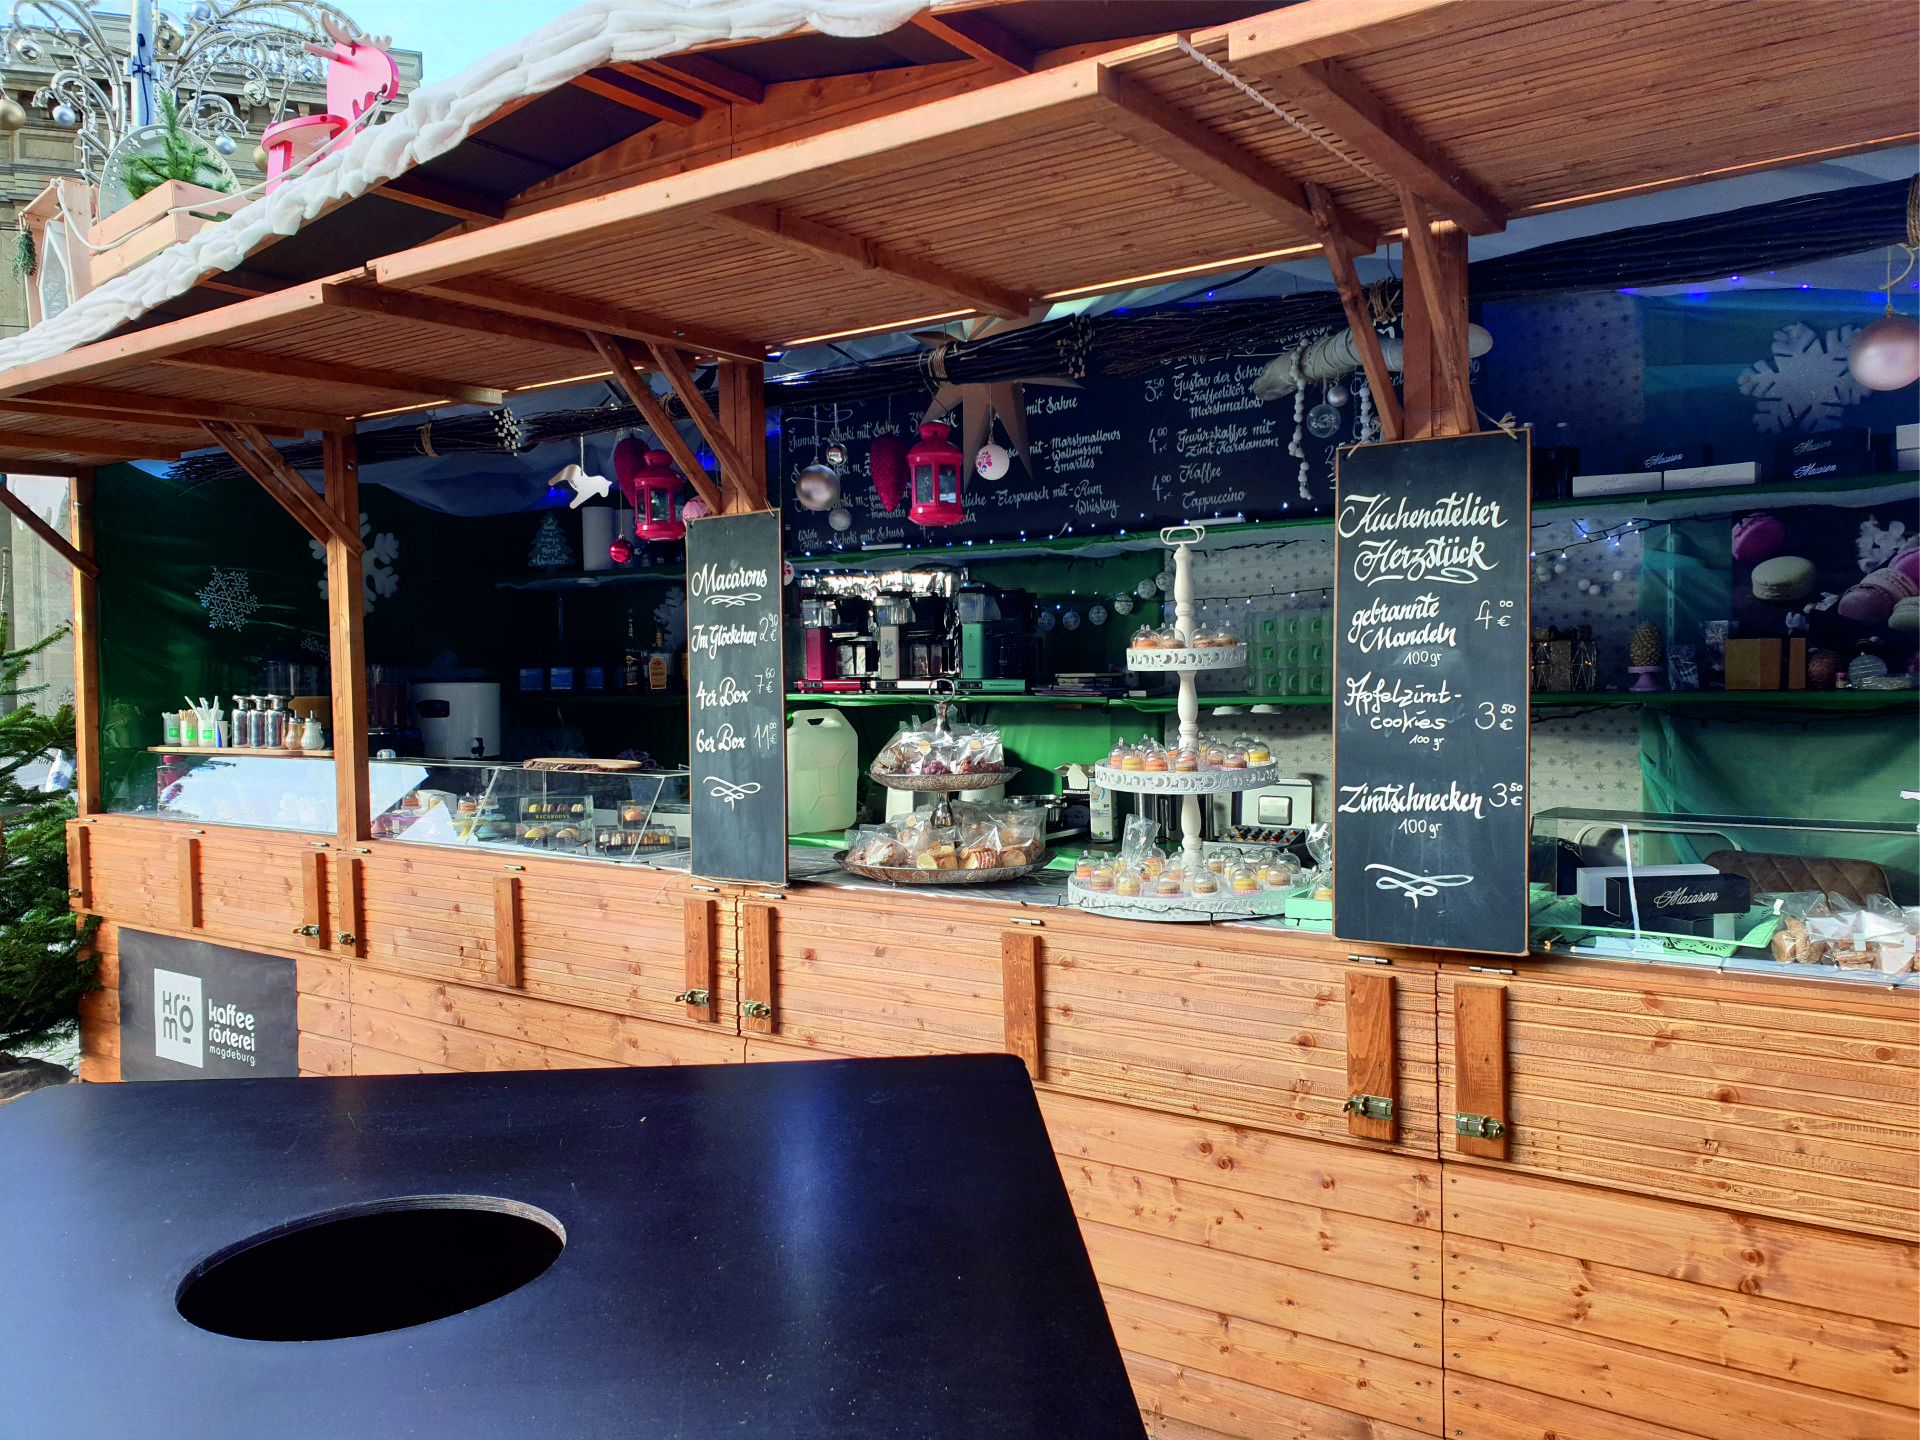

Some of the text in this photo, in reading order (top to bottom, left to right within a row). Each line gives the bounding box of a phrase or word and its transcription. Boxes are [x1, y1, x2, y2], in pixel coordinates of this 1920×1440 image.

[1172, 370, 1211, 400] Gustav
[1026, 396, 1078, 416] mit Sahne
[856, 422, 873, 440] mit
[873, 421, 901, 436] Sahne
[1176, 424, 1248, 453] Gewürzkaffee
[1252, 419, 1276, 435] mit
[1185, 443, 1213, 458] Zimt
[1644, 452, 1684, 469] Macaron
[1793, 438, 1832, 456] Macaron
[1179, 462, 1222, 484] Kaffee
[1793, 462, 1837, 479] Macaron
[1053, 482, 1070, 498] mit
[1338, 491, 1508, 538] Kuchenatelier
[860, 528, 876, 542] mit
[877, 526, 905, 542] Schuss
[1354, 536, 1500, 582] Herzstück
[691, 563, 768, 597] Macarons
[1347, 592, 1440, 643] gebrannte
[708, 624, 758, 660] Glöckchen
[1360, 622, 1457, 653] Mandeln
[696, 681, 718, 710] 4er
[719, 676, 751, 707] Box
[1370, 709, 1448, 733] cookies
[695, 728, 717, 754] 6er
[716, 723, 746, 751] Box
[1337, 780, 1487, 820] Zimtschnecken
[1653, 886, 1719, 909] Macaron
[208, 998, 256, 1032] kaffee
[208, 1024, 256, 1052] rösterei
[209, 1045, 256, 1067] magdeburg
